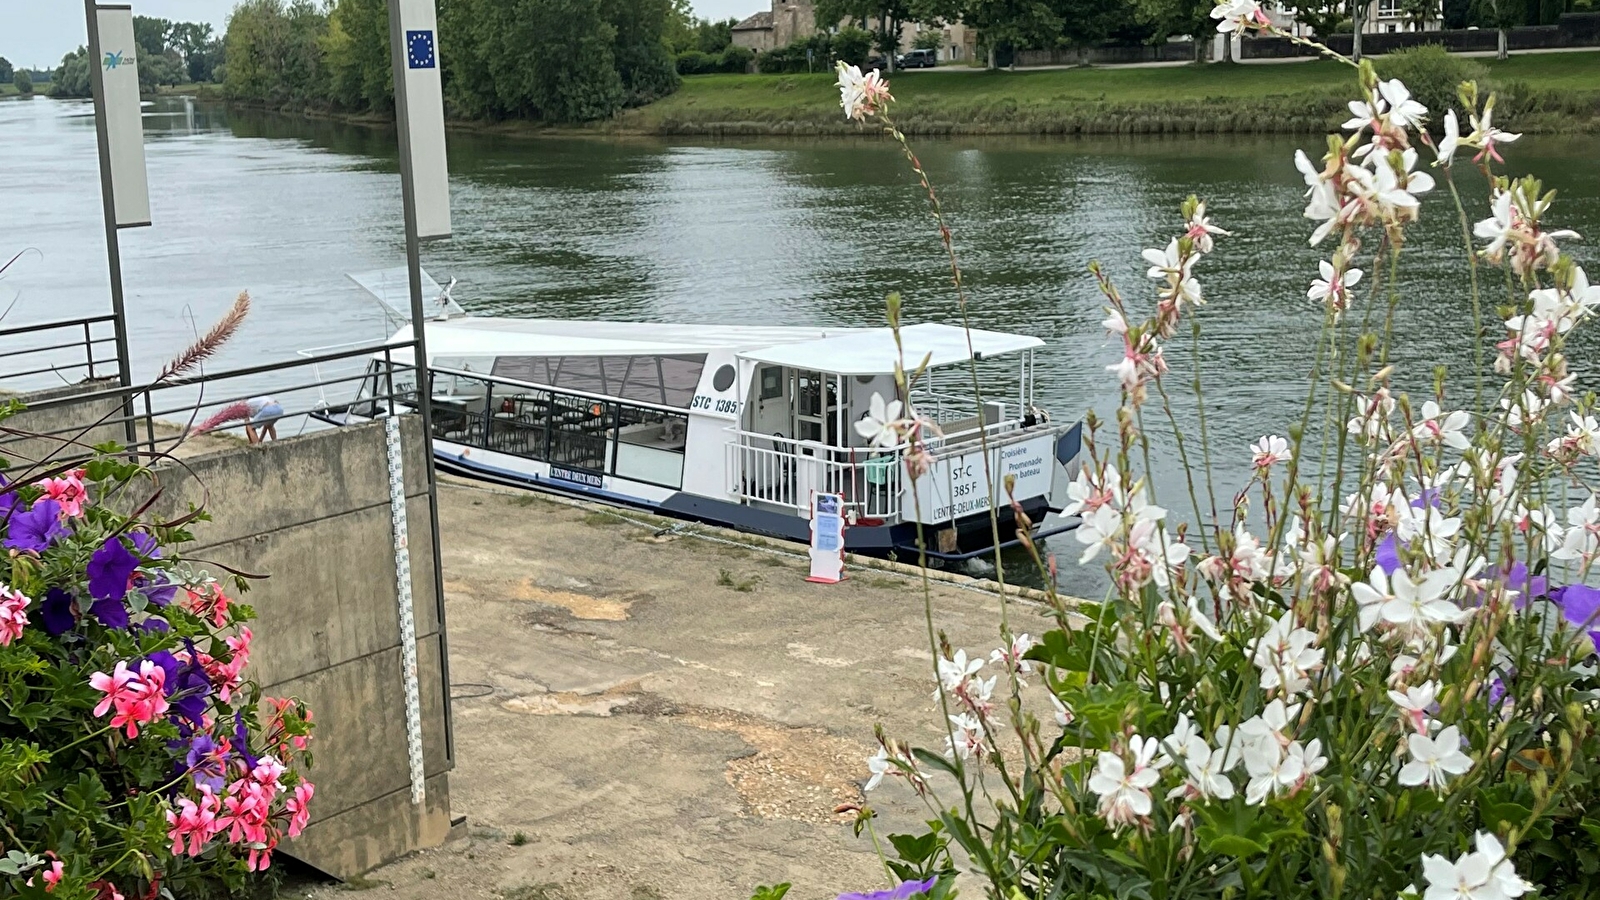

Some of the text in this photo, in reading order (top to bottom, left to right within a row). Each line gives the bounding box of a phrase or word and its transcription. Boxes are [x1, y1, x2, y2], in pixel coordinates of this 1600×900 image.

[692, 395, 712, 410] STC
[715, 399, 738, 414] 1385
[1001, 447, 1027, 460] Croisière
[1009, 456, 1043, 471] Promenade
[571, 471, 587, 484] DEUX
[586, 474, 603, 486] MERS
[953, 465, 973, 480] ST-C
[1019, 467, 1041, 479] bateau
[953, 481, 977, 498] 385 F
[401, 536, 407, 547] 4
